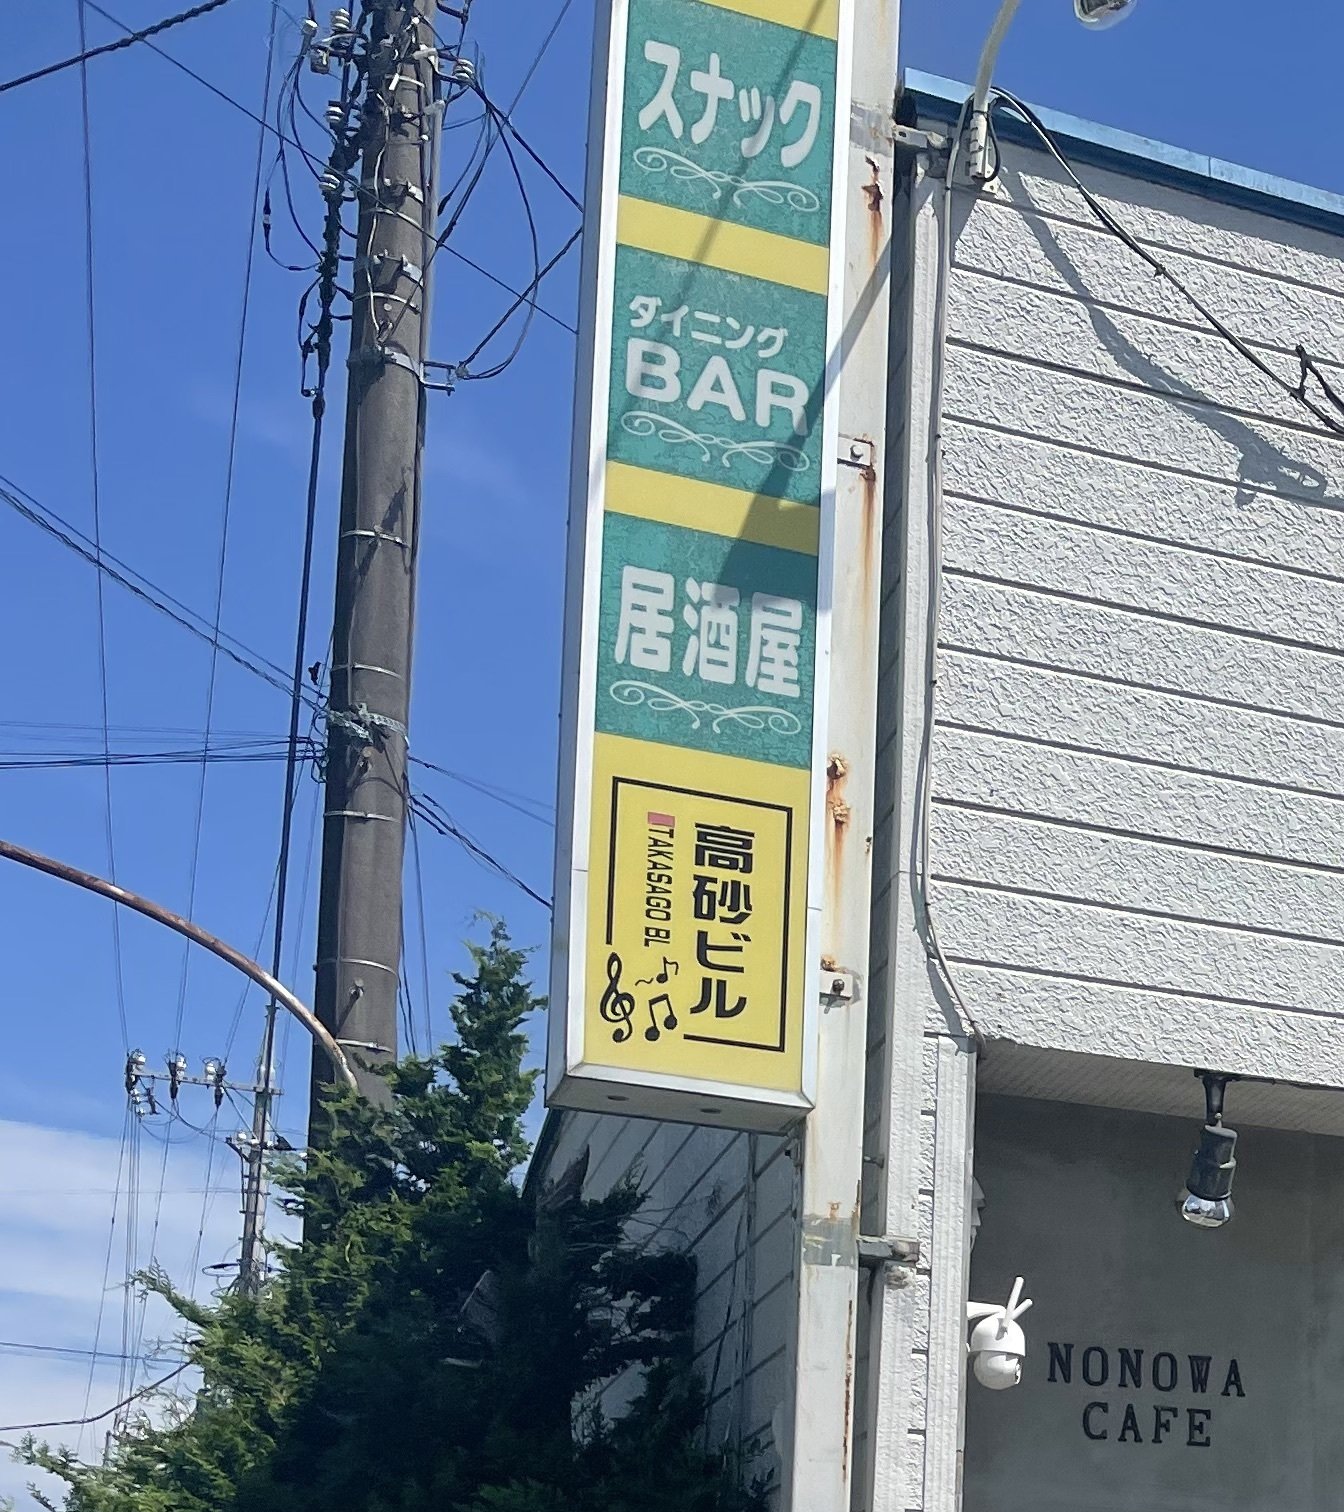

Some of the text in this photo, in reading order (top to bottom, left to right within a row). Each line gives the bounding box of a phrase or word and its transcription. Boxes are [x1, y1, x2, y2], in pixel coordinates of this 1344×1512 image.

[637, 39, 822, 169] スナック
[628, 295, 788, 359] ダイニング
[625, 336, 810, 437] BAR
[614, 565, 802, 698] 居酒屋
[643, 827, 675, 948] TAKASAGO BL
[690, 821, 757, 1020] 高砂ビル
[1047, 1342, 1246, 1397] NONOWA
[1082, 1401, 1212, 1447] CAFE
